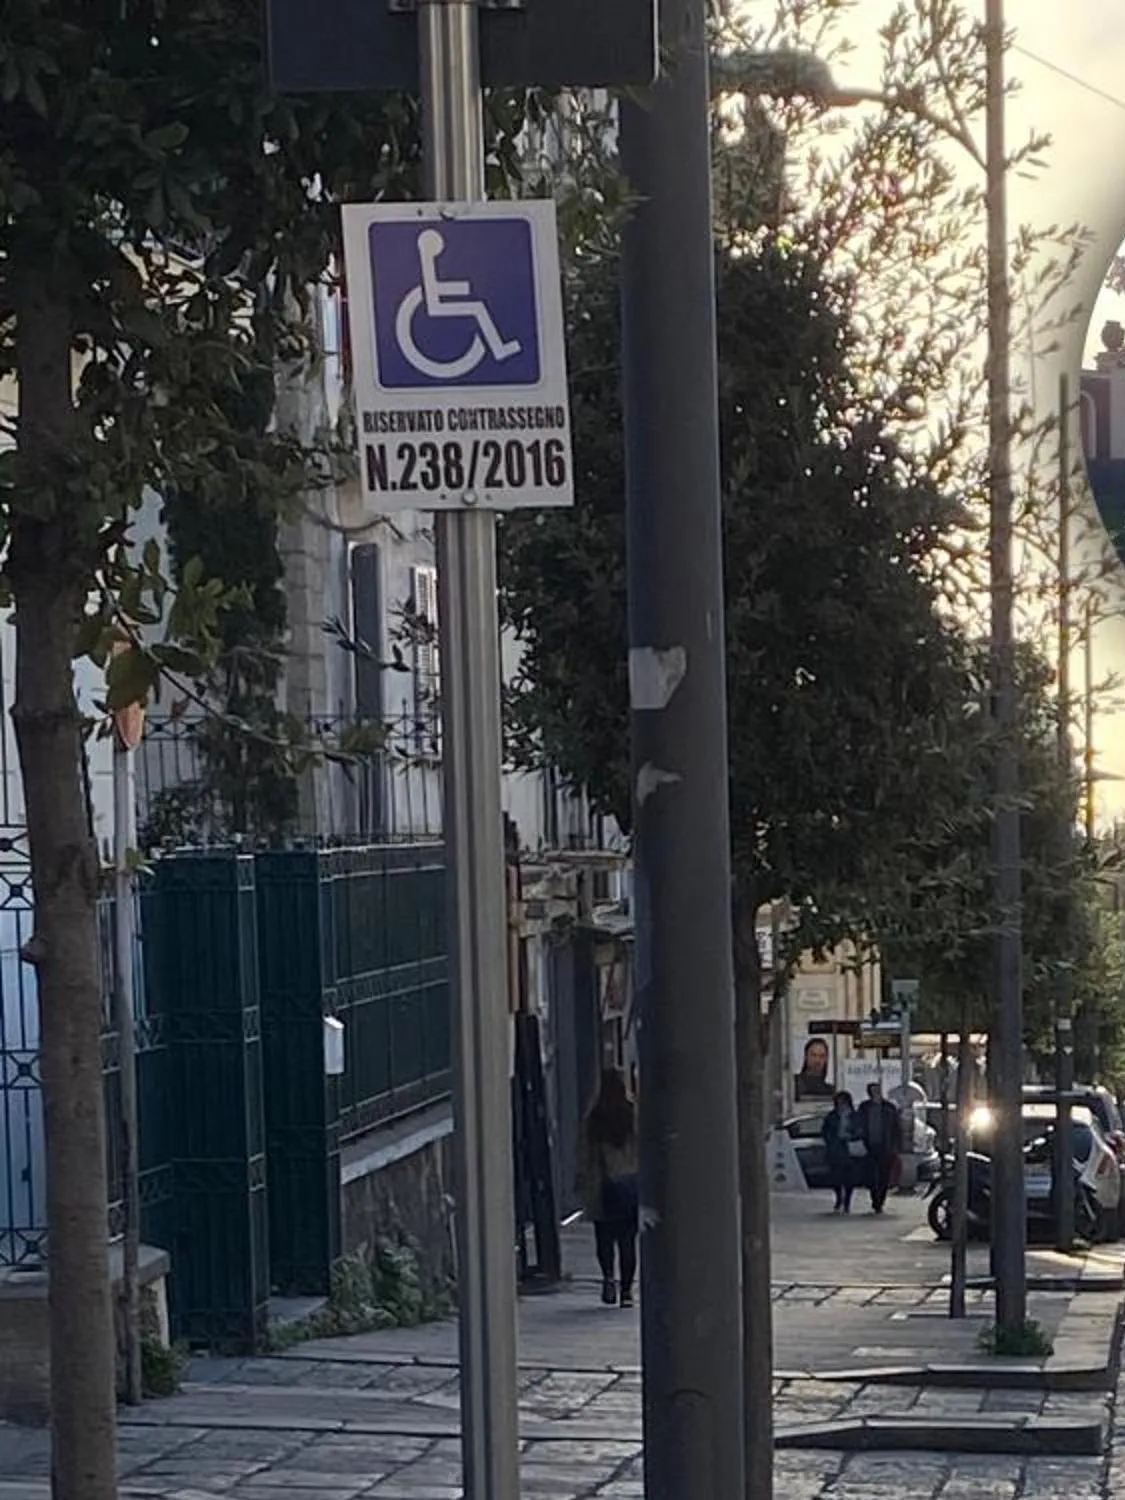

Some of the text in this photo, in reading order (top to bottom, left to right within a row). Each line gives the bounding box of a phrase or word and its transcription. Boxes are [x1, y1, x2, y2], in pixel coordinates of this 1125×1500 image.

[362, 406, 565, 434] RISERVATO CONTRASSEGNO
[365, 438, 566, 492] N.238/2016
